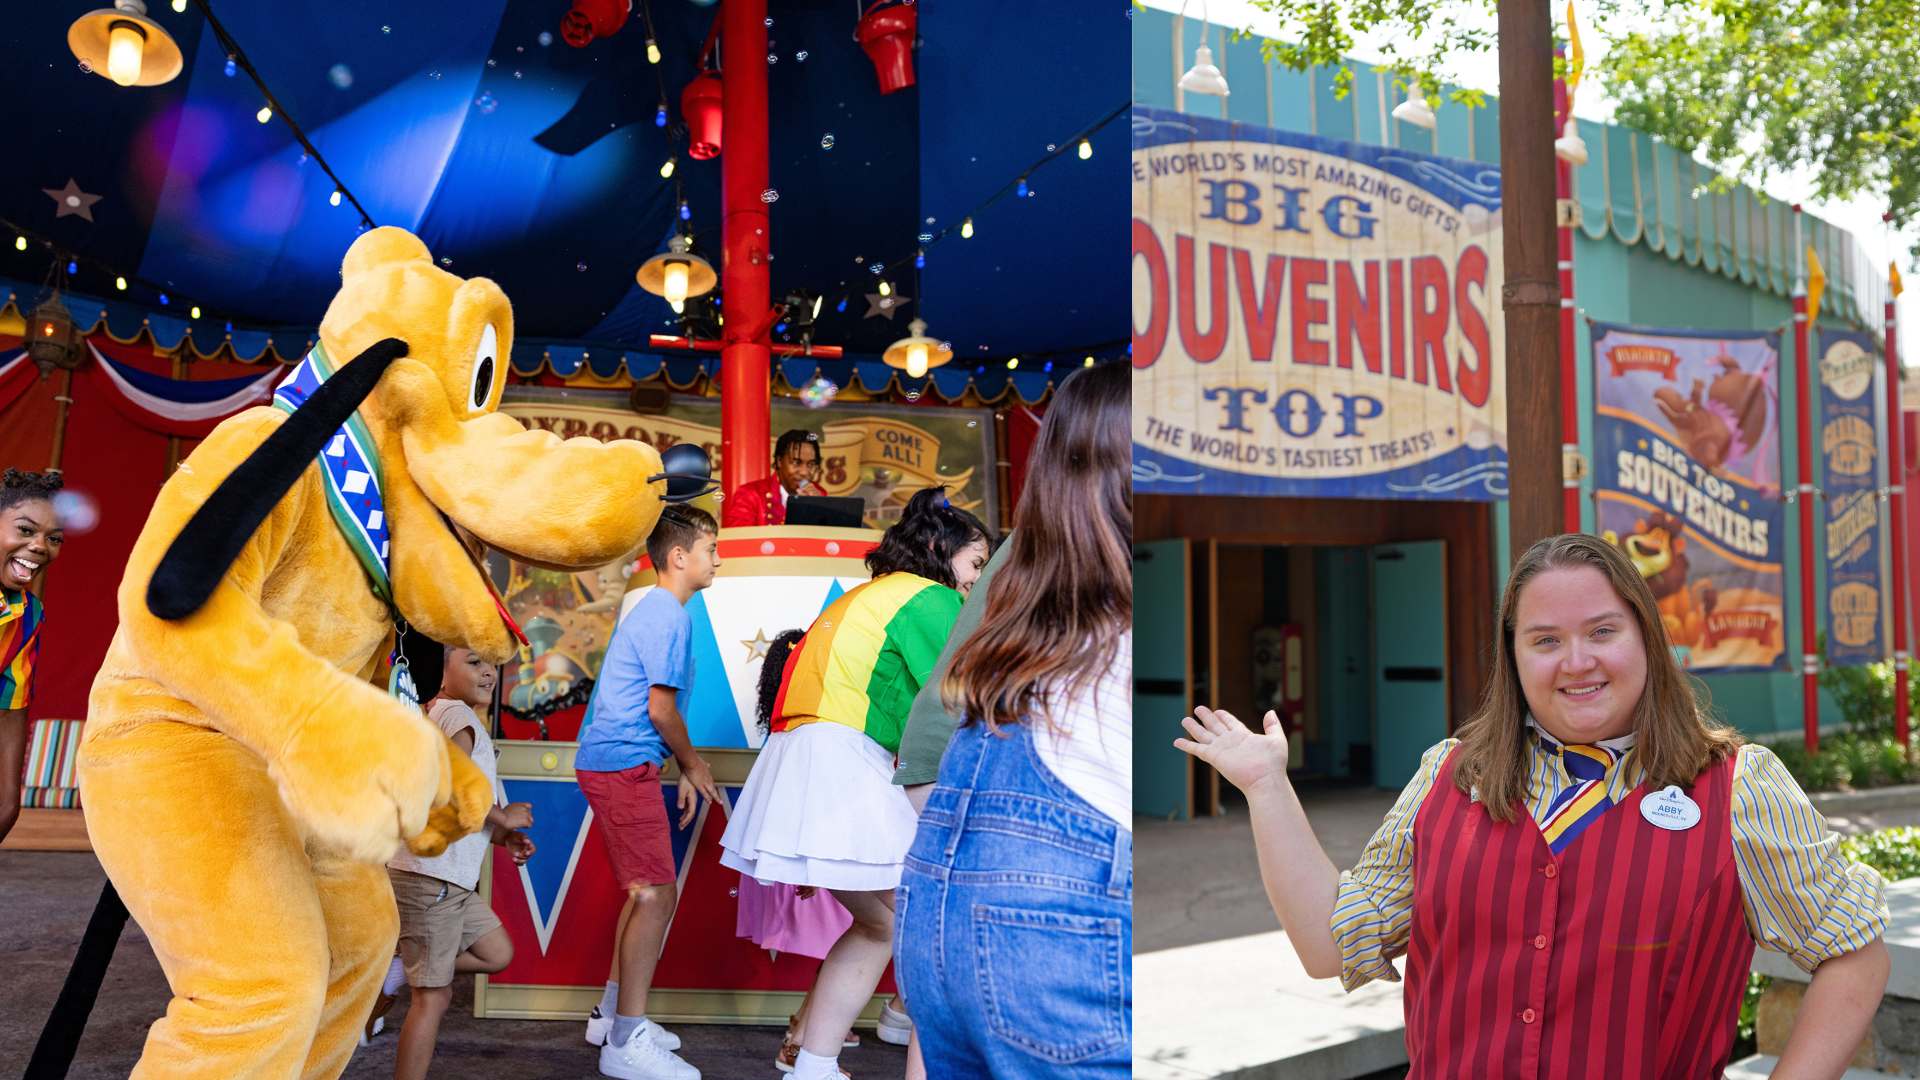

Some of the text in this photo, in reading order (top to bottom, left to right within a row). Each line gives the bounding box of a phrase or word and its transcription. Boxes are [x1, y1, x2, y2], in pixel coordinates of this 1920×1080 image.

[1149, 152, 1246, 177] WORLD'S
[1253, 153, 1310, 178] MOST
[1315, 163, 1402, 205] AMAZING
[1405, 194, 1461, 236] GIFTS!
[1199, 178, 1380, 240] BIG
[1202, 384, 1384, 438] TOP
[875, 429, 924, 452] COME
[883, 444, 921, 468] ALL!
[1146, 416, 1437, 468] THE WORLD'S TASTIEST TREATS!
[1652, 437, 1736, 504] BIG TOP
[1617, 449, 1769, 558] SOUVENIRS
[1657, 804, 1683, 815] ABBY
